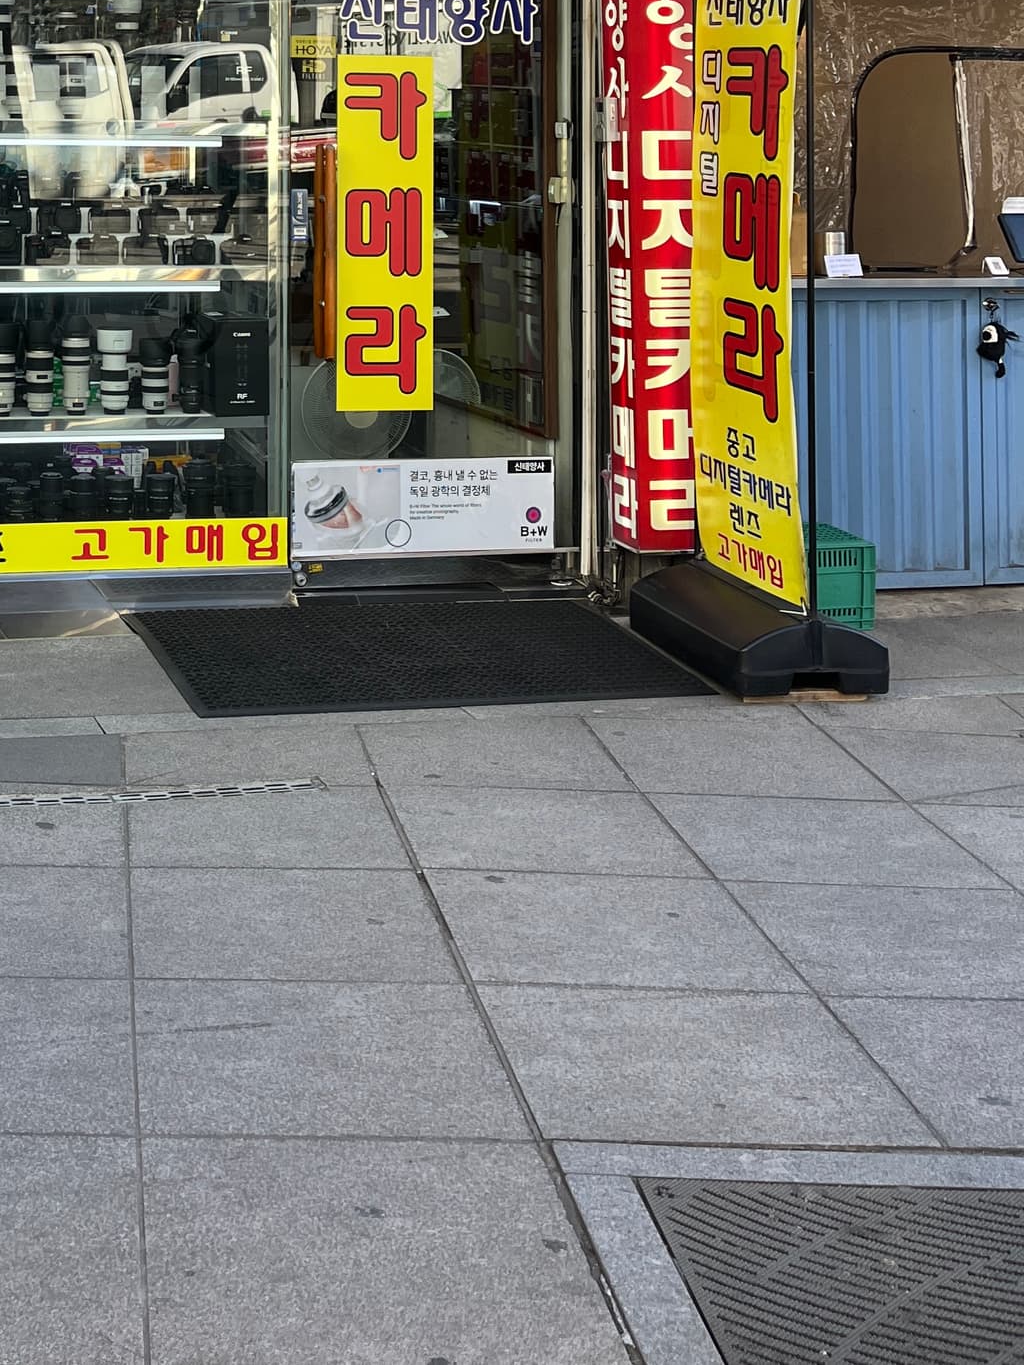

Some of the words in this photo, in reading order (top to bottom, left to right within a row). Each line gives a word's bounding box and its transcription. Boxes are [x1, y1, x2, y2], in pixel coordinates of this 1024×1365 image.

[296, 45, 333, 55] HOYA
[345, 71, 427, 395] 카메라
[723, 43, 789, 424] 카메라
[726, 426, 757, 462] 중고
[467, 469, 477, 480] 수
[514, 461, 545, 472] 신태양사
[409, 486, 429, 498] 독일
[699, 453, 792, 517] 디지털카메라
[520, 525, 548, 537] B+W
[729, 502, 762, 539] 렌즈
[71, 522, 279, 563] 고가매입
[718, 532, 784, 590] 고가매입
